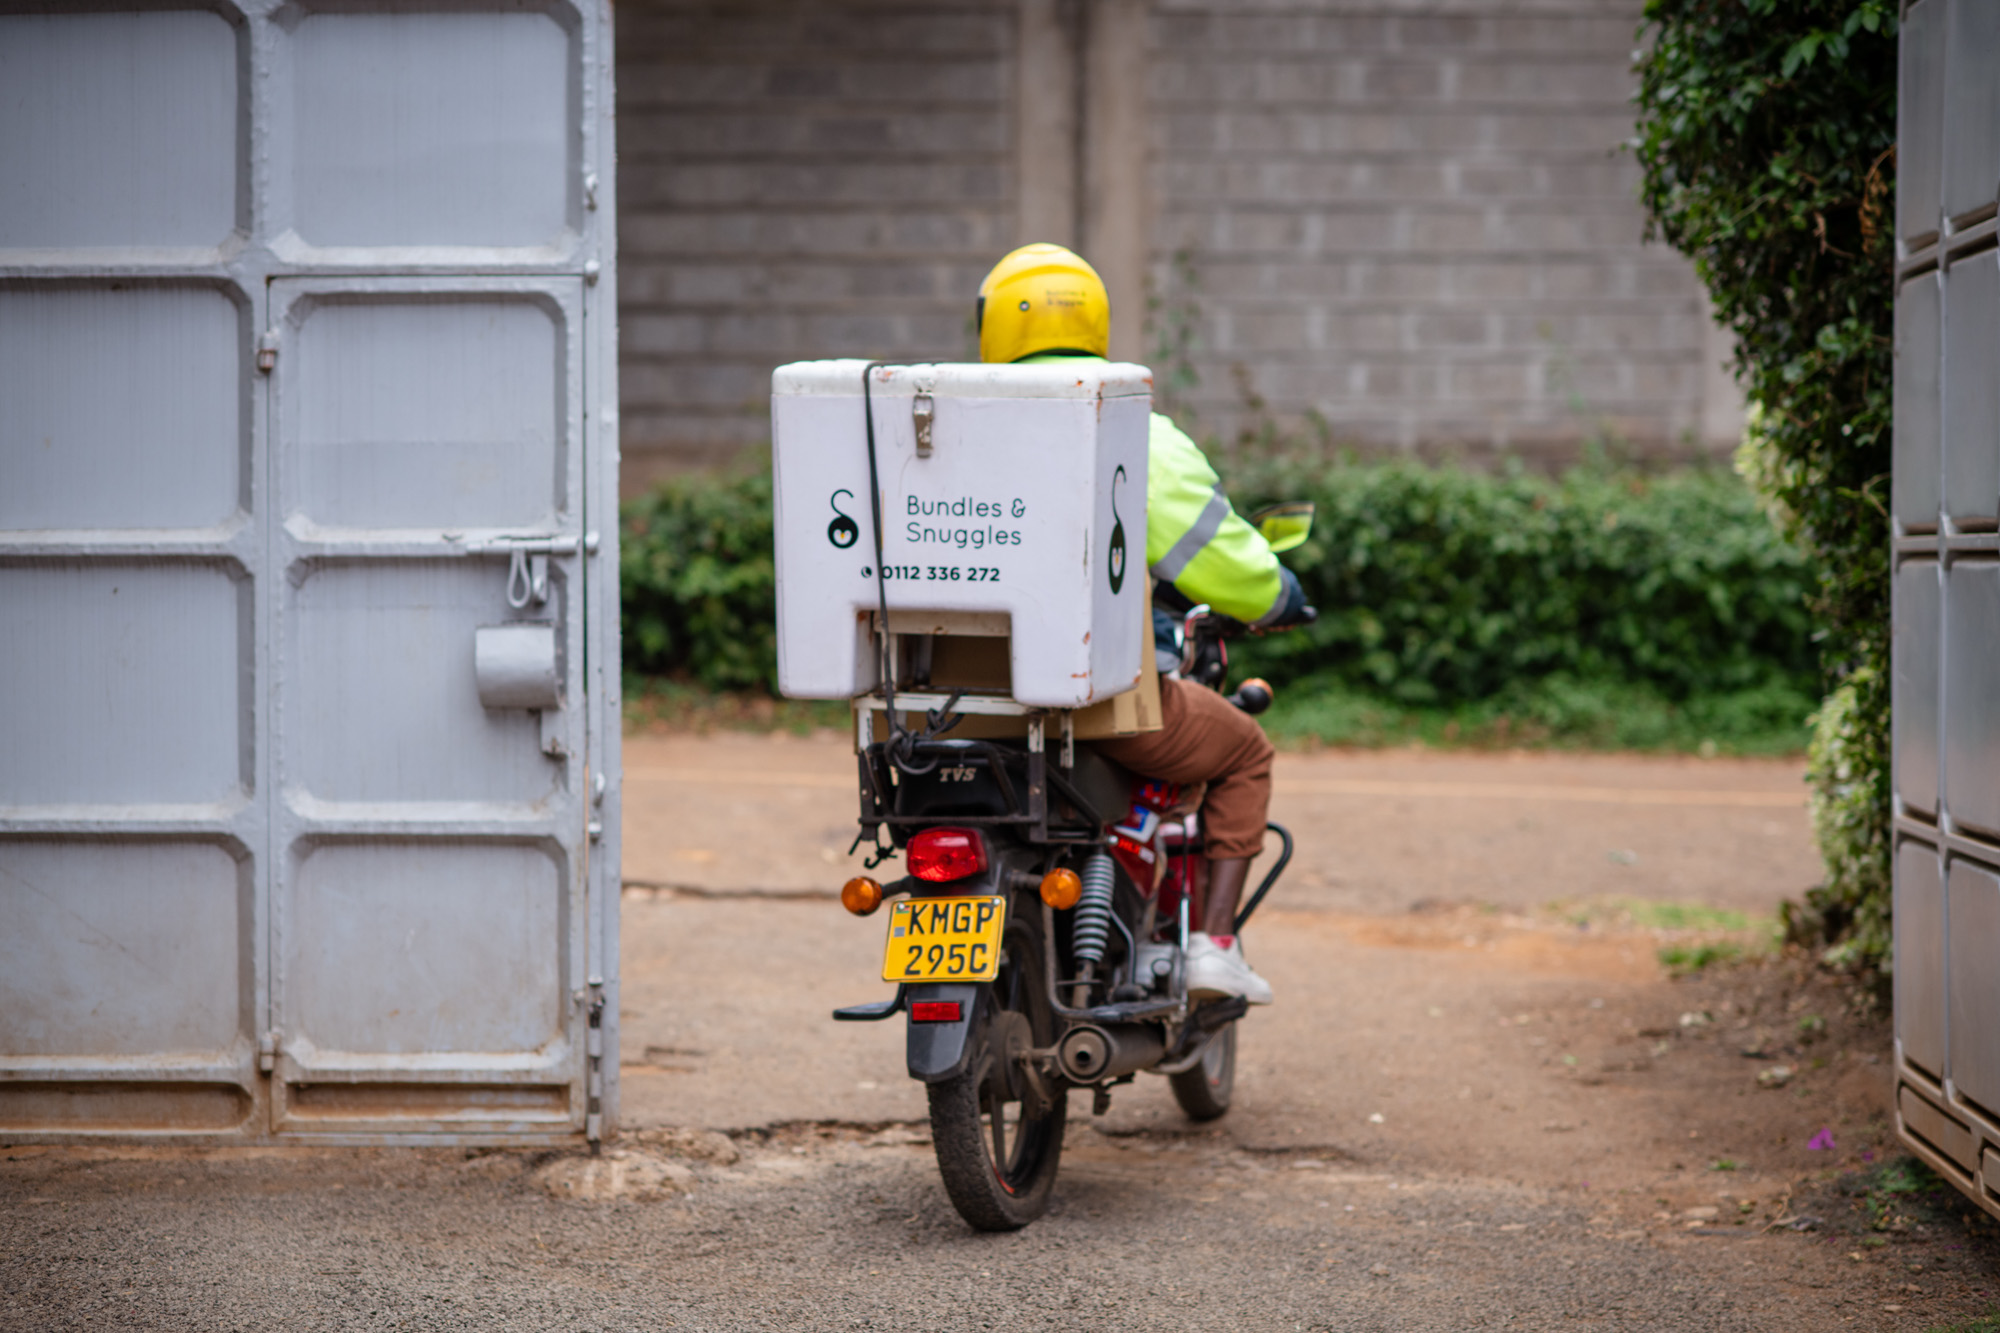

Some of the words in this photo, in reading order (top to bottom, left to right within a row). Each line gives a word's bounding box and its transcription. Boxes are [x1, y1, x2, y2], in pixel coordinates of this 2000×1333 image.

[906, 495, 1003, 518] Bundles
[1011, 498, 1026, 518] &
[906, 521, 1022, 549] Snuggles
[881, 565, 921, 580] 0112
[927, 566, 961, 581] 336
[967, 567, 1001, 582] 272
[939, 767, 977, 783] TVS
[908, 902, 995, 935] KMGP
[904, 943, 989, 976] 295C
